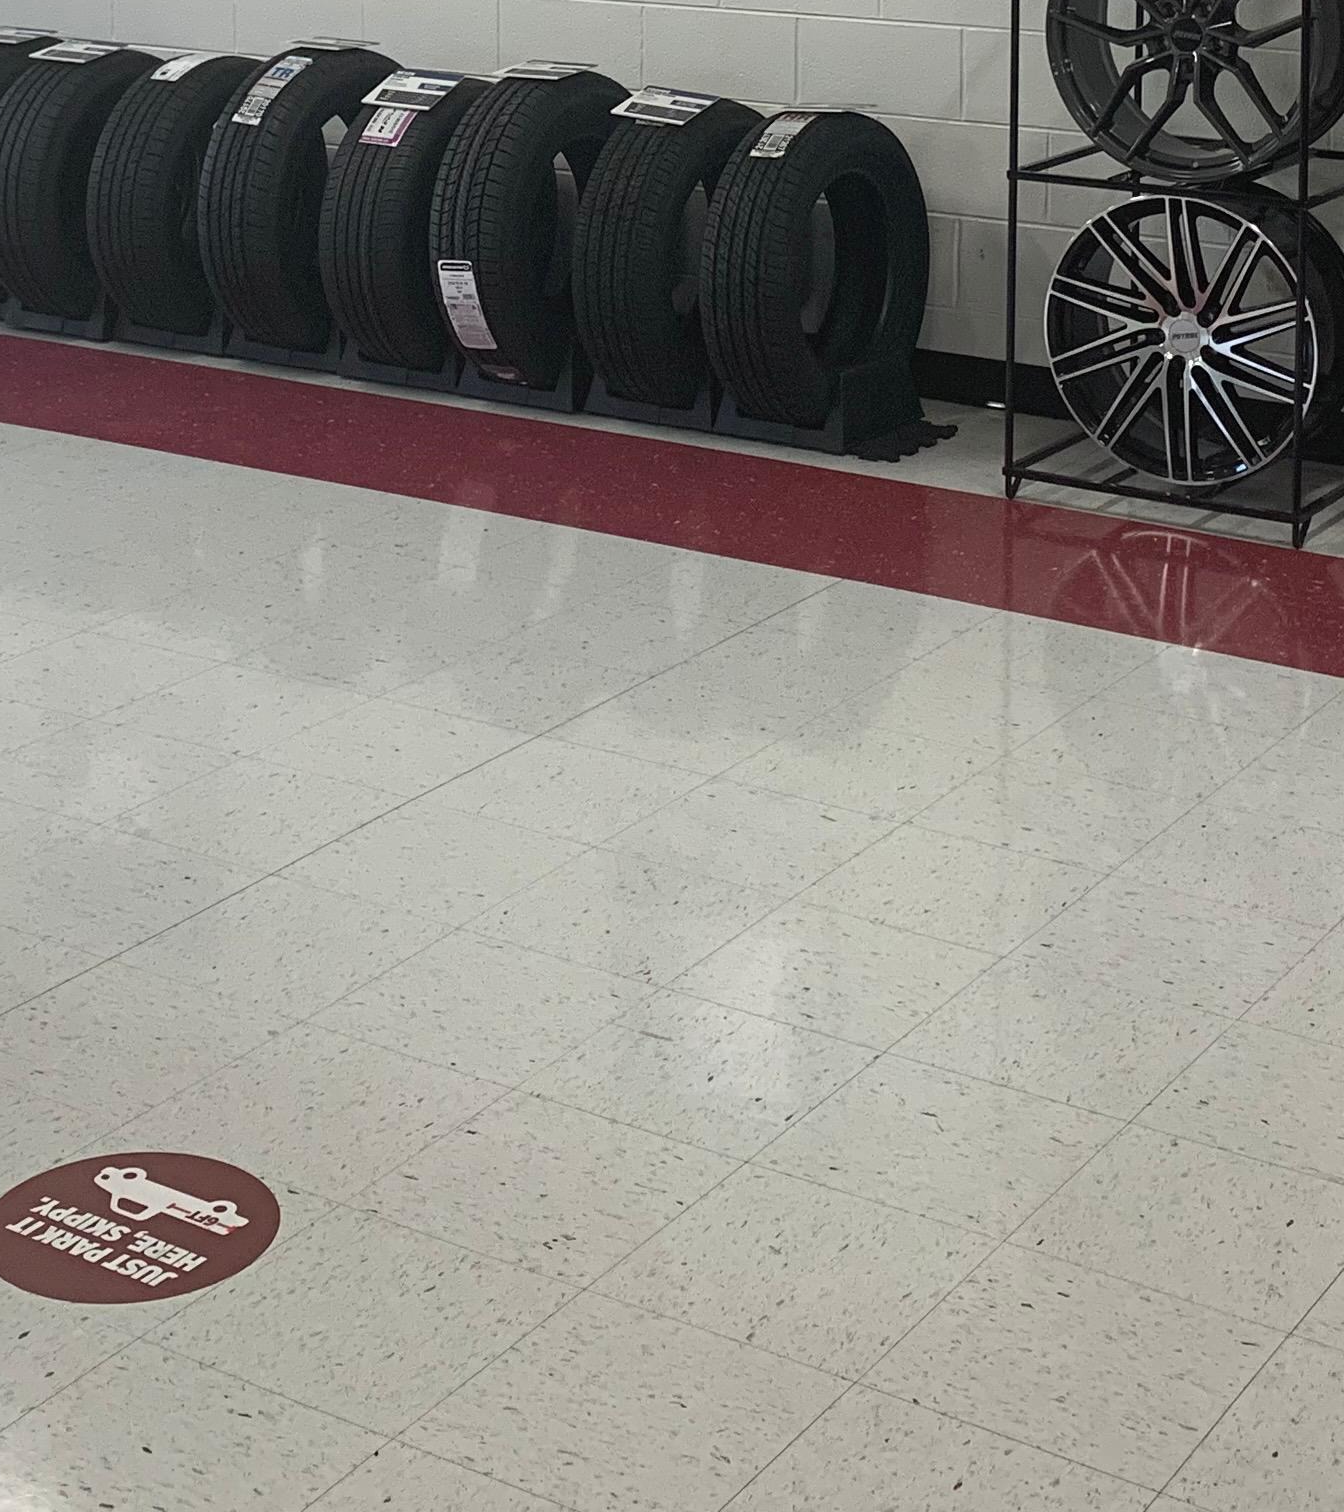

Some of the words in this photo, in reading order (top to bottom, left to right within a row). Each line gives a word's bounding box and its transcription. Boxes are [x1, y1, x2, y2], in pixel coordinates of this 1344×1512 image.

[271, 67, 295, 79] TR
[5, 1217, 46, 1237] IT
[29, 1196, 131, 1242] SKIPPY.
[184, 1208, 220, 1226] 6FT
[32, 1225, 114, 1264] PARK
[127, 1231, 207, 1272] HERE,
[100, 1255, 178, 1287] JUST
